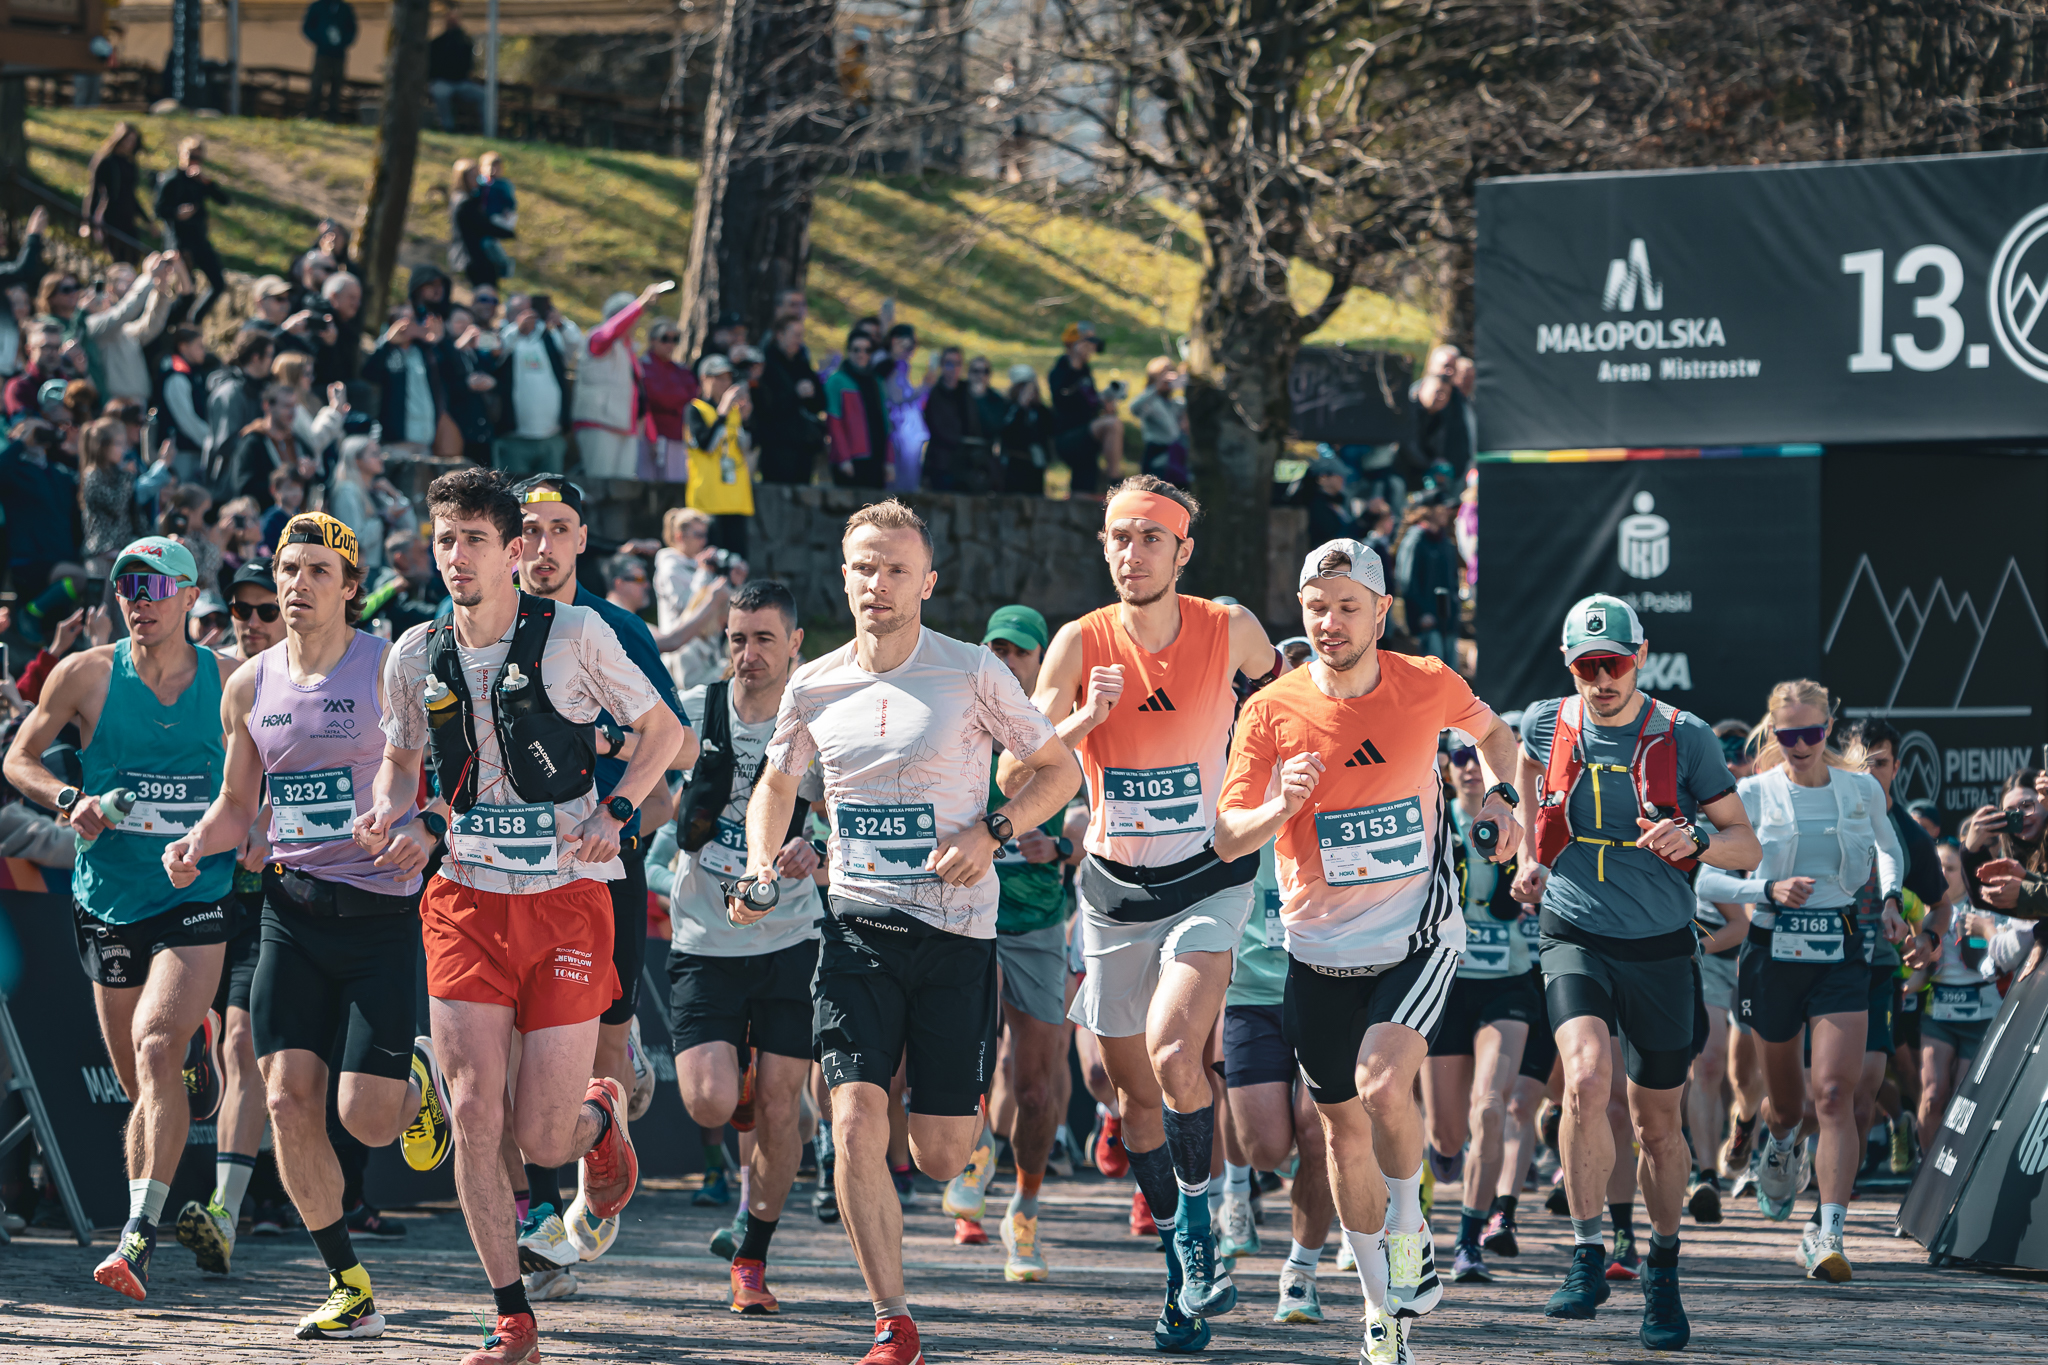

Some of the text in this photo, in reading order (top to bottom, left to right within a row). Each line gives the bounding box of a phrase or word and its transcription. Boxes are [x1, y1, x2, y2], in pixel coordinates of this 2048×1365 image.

[1841, 244, 1990, 373] 13.
[1537, 317, 1726, 354] MAŁOPOLSKA
[1598, 356, 1761, 382] Arena Mistrzostw
[261, 713, 292, 728] HOKA
[533, 740, 558, 774] SALOMON
[1945, 748, 2032, 782] PIENINY
[138, 781, 187, 800] 3993
[284, 782, 328, 802] 3232
[1122, 778, 1174, 797] 3103
[1945, 786, 2003, 811] ULTRA-T
[470, 815, 526, 834] 3158
[855, 817, 907, 836] 3245
[1340, 815, 1398, 841] 3153
[183, 911, 223, 926] GARMIN
[856, 917, 908, 933] SALOMON
[1790, 917, 1828, 932] 3168
[554, 969, 589, 982] TOMGA
